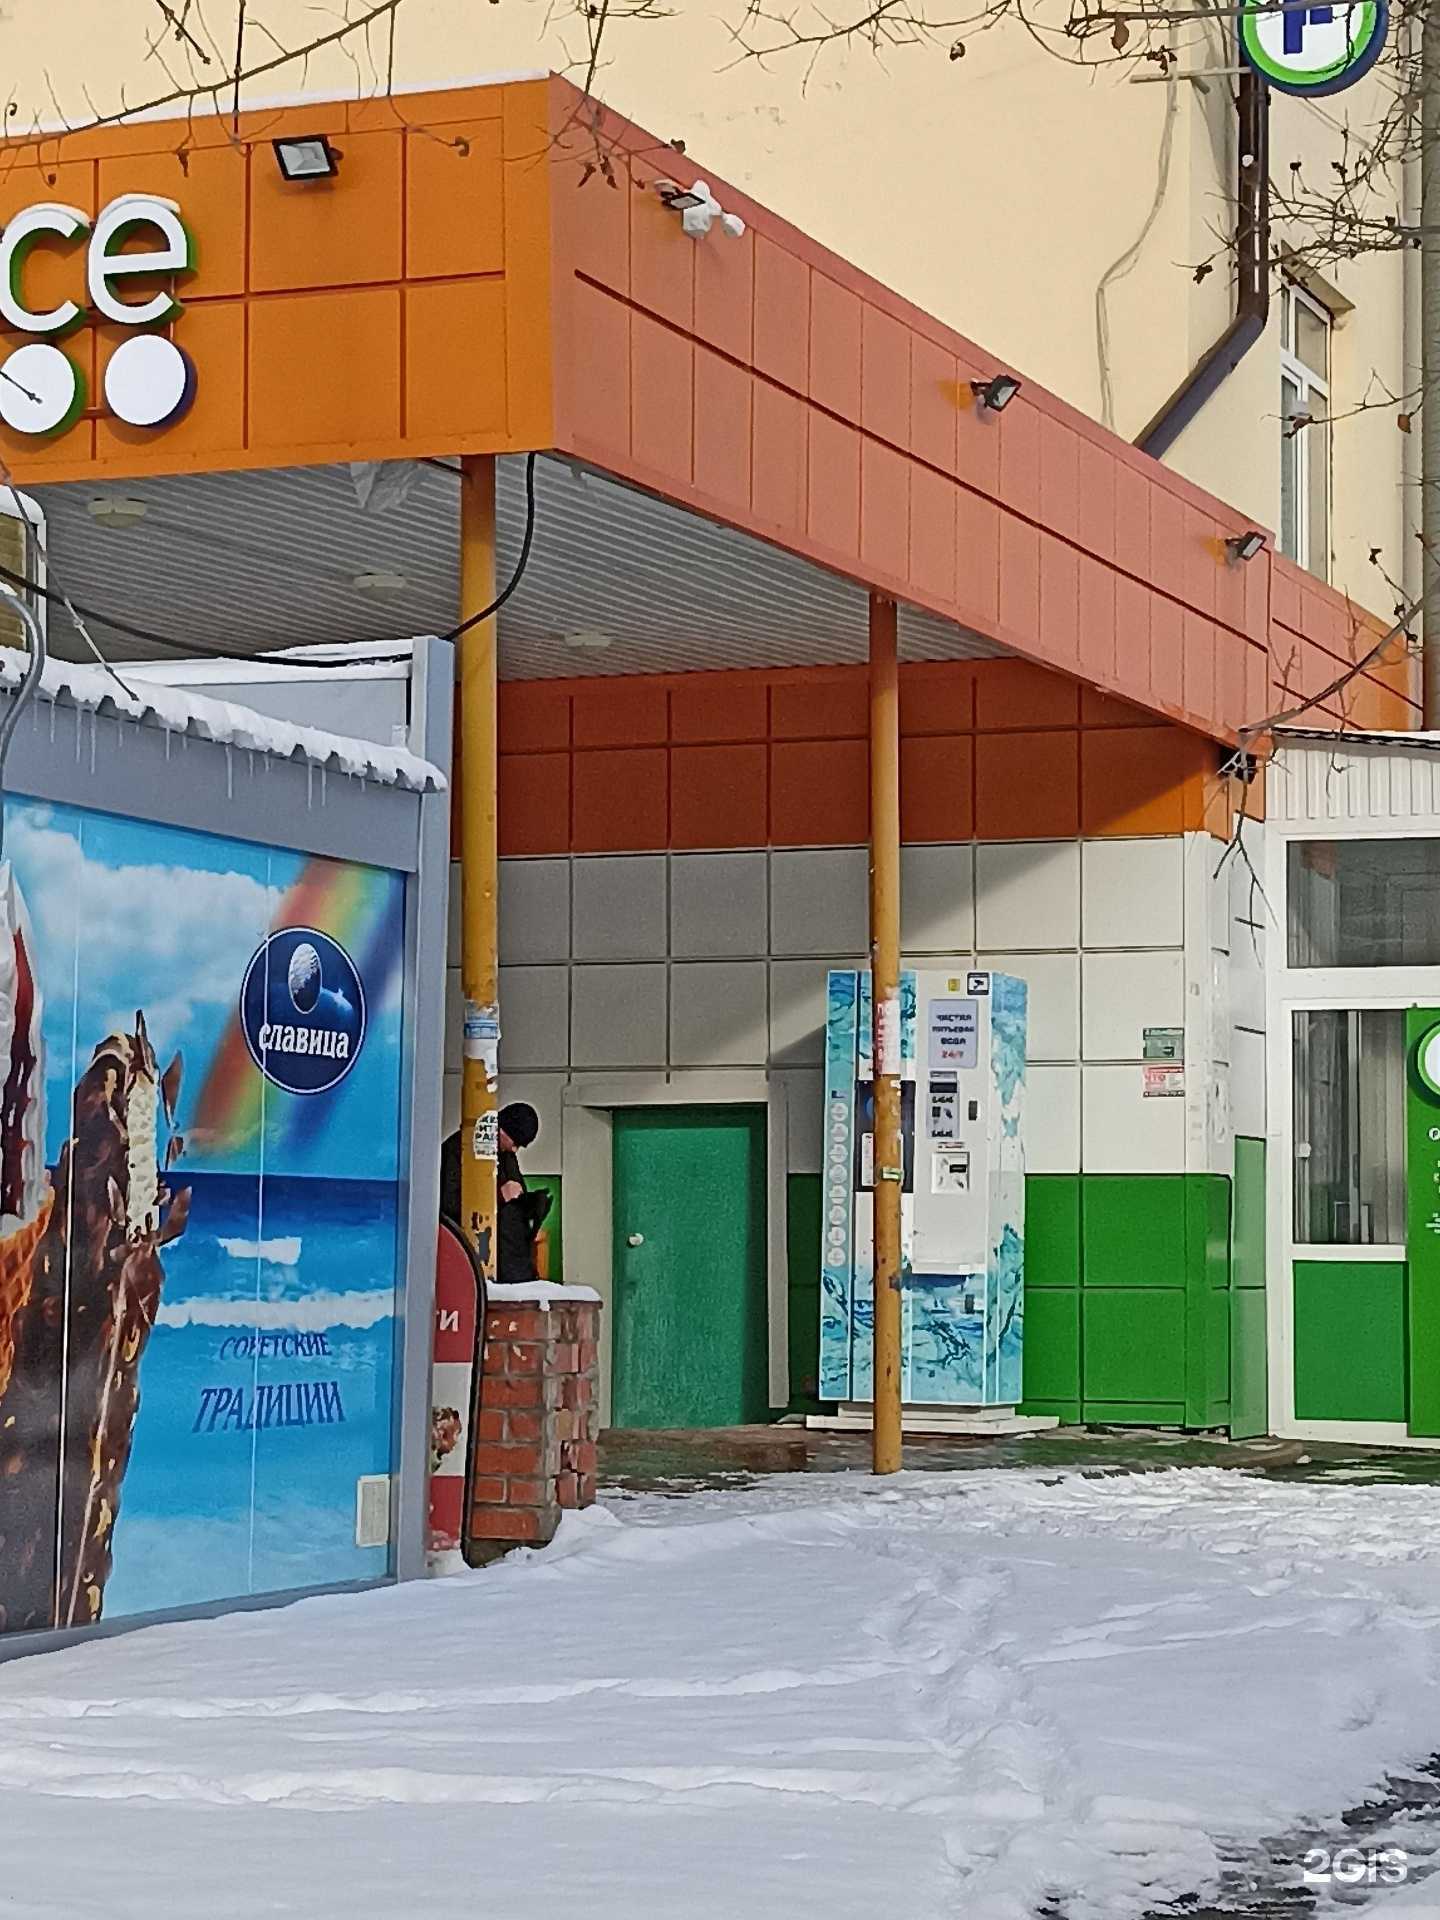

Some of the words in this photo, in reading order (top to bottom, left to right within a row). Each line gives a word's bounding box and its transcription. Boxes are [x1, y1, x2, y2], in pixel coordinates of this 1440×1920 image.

[436, 1309, 459, 1332] И
[220, 1333, 333, 1360] СОВЕТСКИЕ
[192, 1381, 347, 1433] ТРАДИЦИИ
